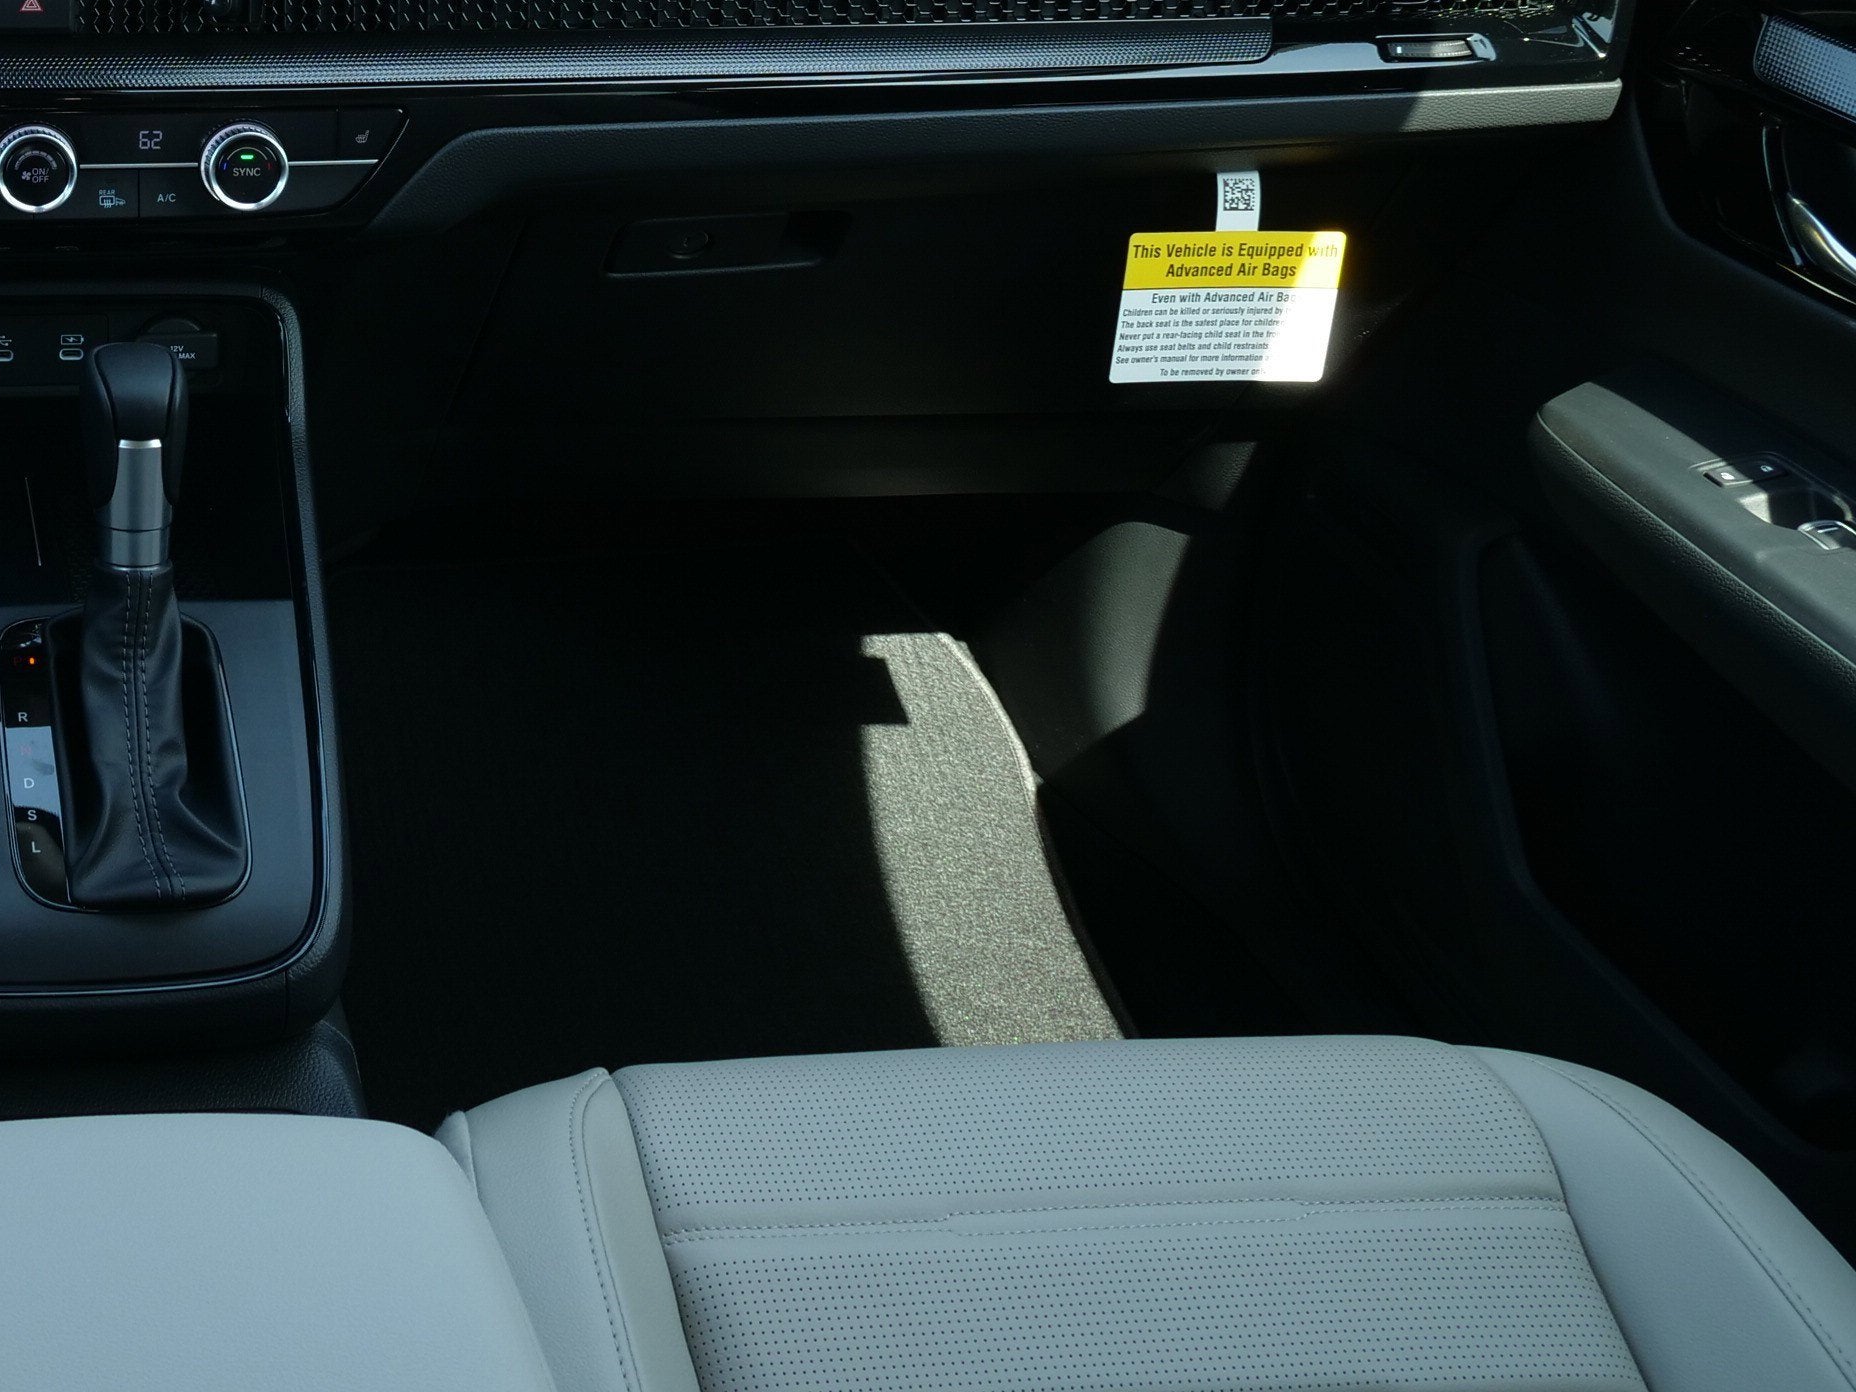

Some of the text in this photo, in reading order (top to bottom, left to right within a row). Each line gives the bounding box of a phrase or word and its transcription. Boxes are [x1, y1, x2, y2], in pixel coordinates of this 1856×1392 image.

[139, 131, 163, 150] 62
[31, 167, 49, 176] ON/
[232, 167, 261, 177] SYNC
[32, 176, 49, 184] OFF
[157, 193, 176, 203] A/C
[1133, 243, 1338, 259] This Vehicle is Equipped with
[1165, 262, 1296, 279] Advanced Air Bags
[1152, 292, 1176, 304] Even
[1179, 292, 1201, 303] with
[1203, 292, 1255, 303] Advanced
[1258, 292, 1273, 302] Air
[1123, 308, 1153, 317] Children
[1169, 308, 1179, 316] be
[1180, 307, 1201, 315] killed
[1211, 307, 1245, 316] seriously
[1246, 306, 1273, 316] injured
[1274, 307, 1284, 316] by
[1121, 320, 1134, 328] The
[1136, 320, 1153, 328] back
[1155, 319, 1171, 328] seat
[1172, 319, 1180, 327] is
[1181, 319, 1193, 327] the
[1195, 318, 1218, 327] safest
[1219, 318, 1240, 328] place
[1242, 318, 1252, 326] for
[1119, 332, 1141, 340] Never
[1142, 332, 1155, 341] put
[1163, 330, 1202, 340] rear-facing
[1204, 330, 1223, 339] child
[1224, 330, 1241, 338] seat
[1243, 330, 1250, 338] in
[1252, 329, 1264, 338] the
[170, 345, 184, 353] 12V
[1117, 344, 1143, 353] Always
[1159, 343, 1176, 351] seat
[1177, 343, 1196, 351] belts
[1197, 342, 1212, 350] and
[1213, 342, 1232, 350] child
[1233, 341, 1269, 350] restraints
[178, 351, 196, 360] MAX
[1115, 353, 1264, 364] See owner's manual for more information
[1160, 368, 1169, 376] To
[1170, 368, 1179, 376] be
[1181, 367, 1214, 376] removed
[1215, 367, 1224, 377] by
[18, 712, 28, 722] R
[24, 777, 35, 789] D
[27, 809, 38, 820] S
[31, 842, 41, 853] L
